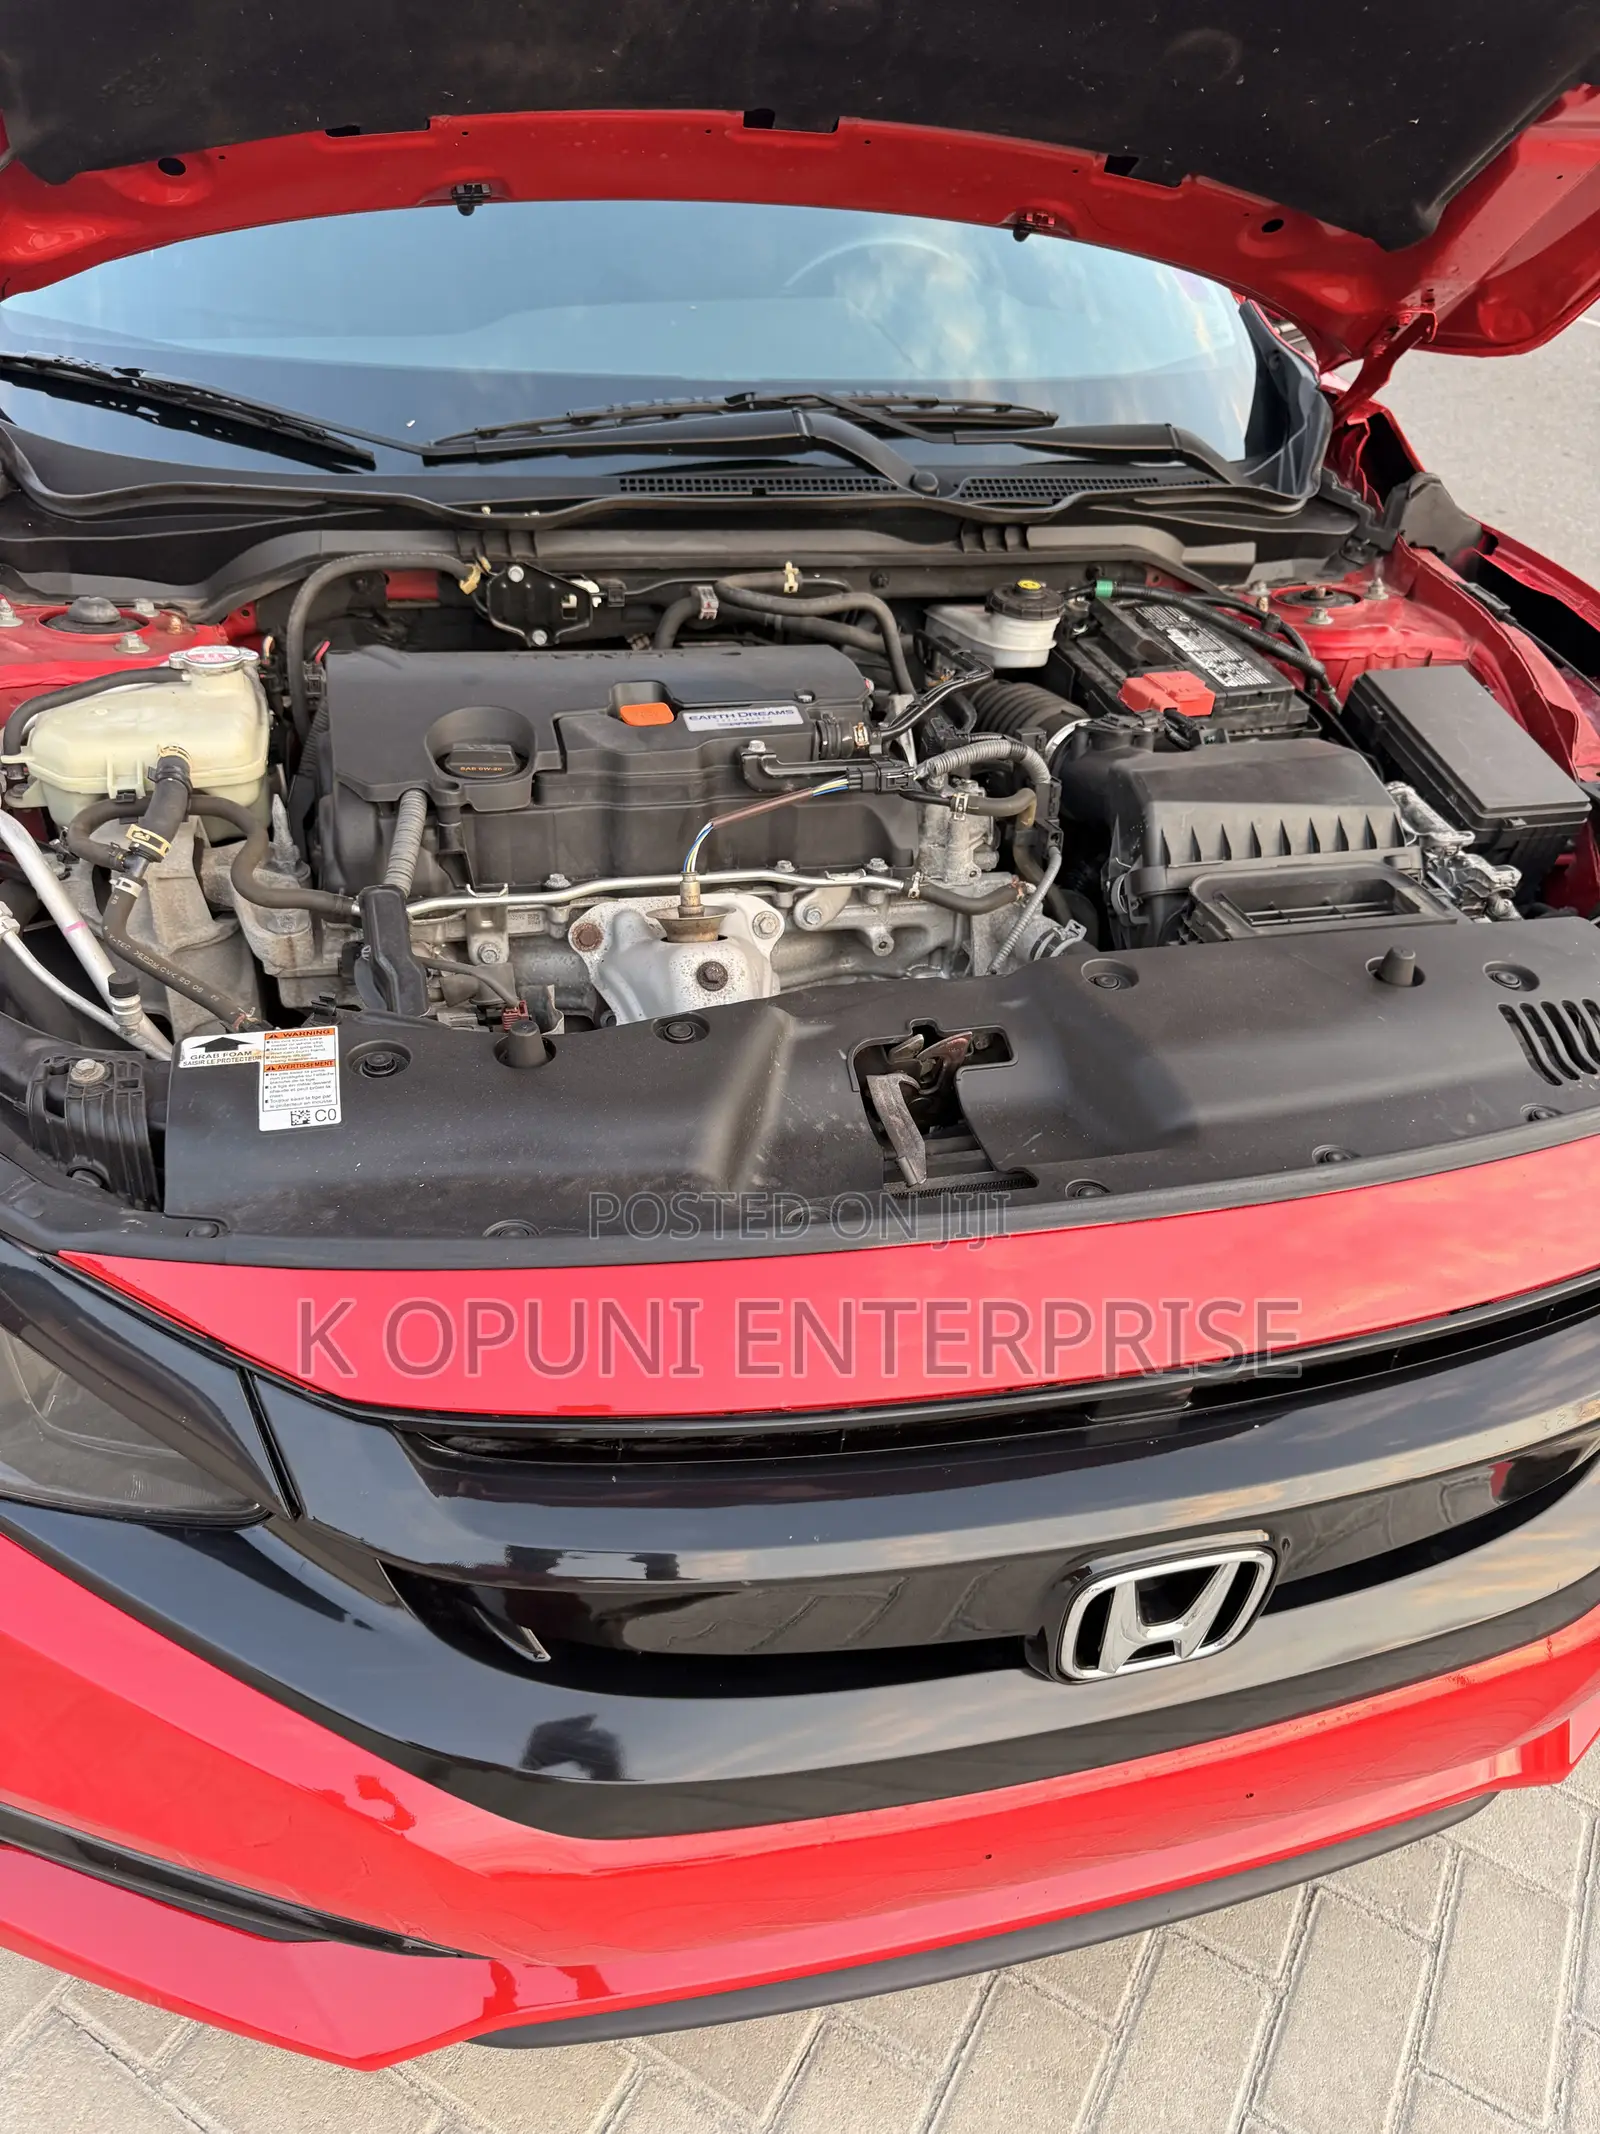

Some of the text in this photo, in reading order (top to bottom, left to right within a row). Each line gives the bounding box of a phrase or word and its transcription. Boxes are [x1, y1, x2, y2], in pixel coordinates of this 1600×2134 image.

[282, 1029, 331, 1038] WARNING
[190, 1050, 253, 1061] GRAB FOAM
[183, 1058, 206, 1067] SAISIR
[277, 1060, 334, 1070] AVERTISSEMENT
